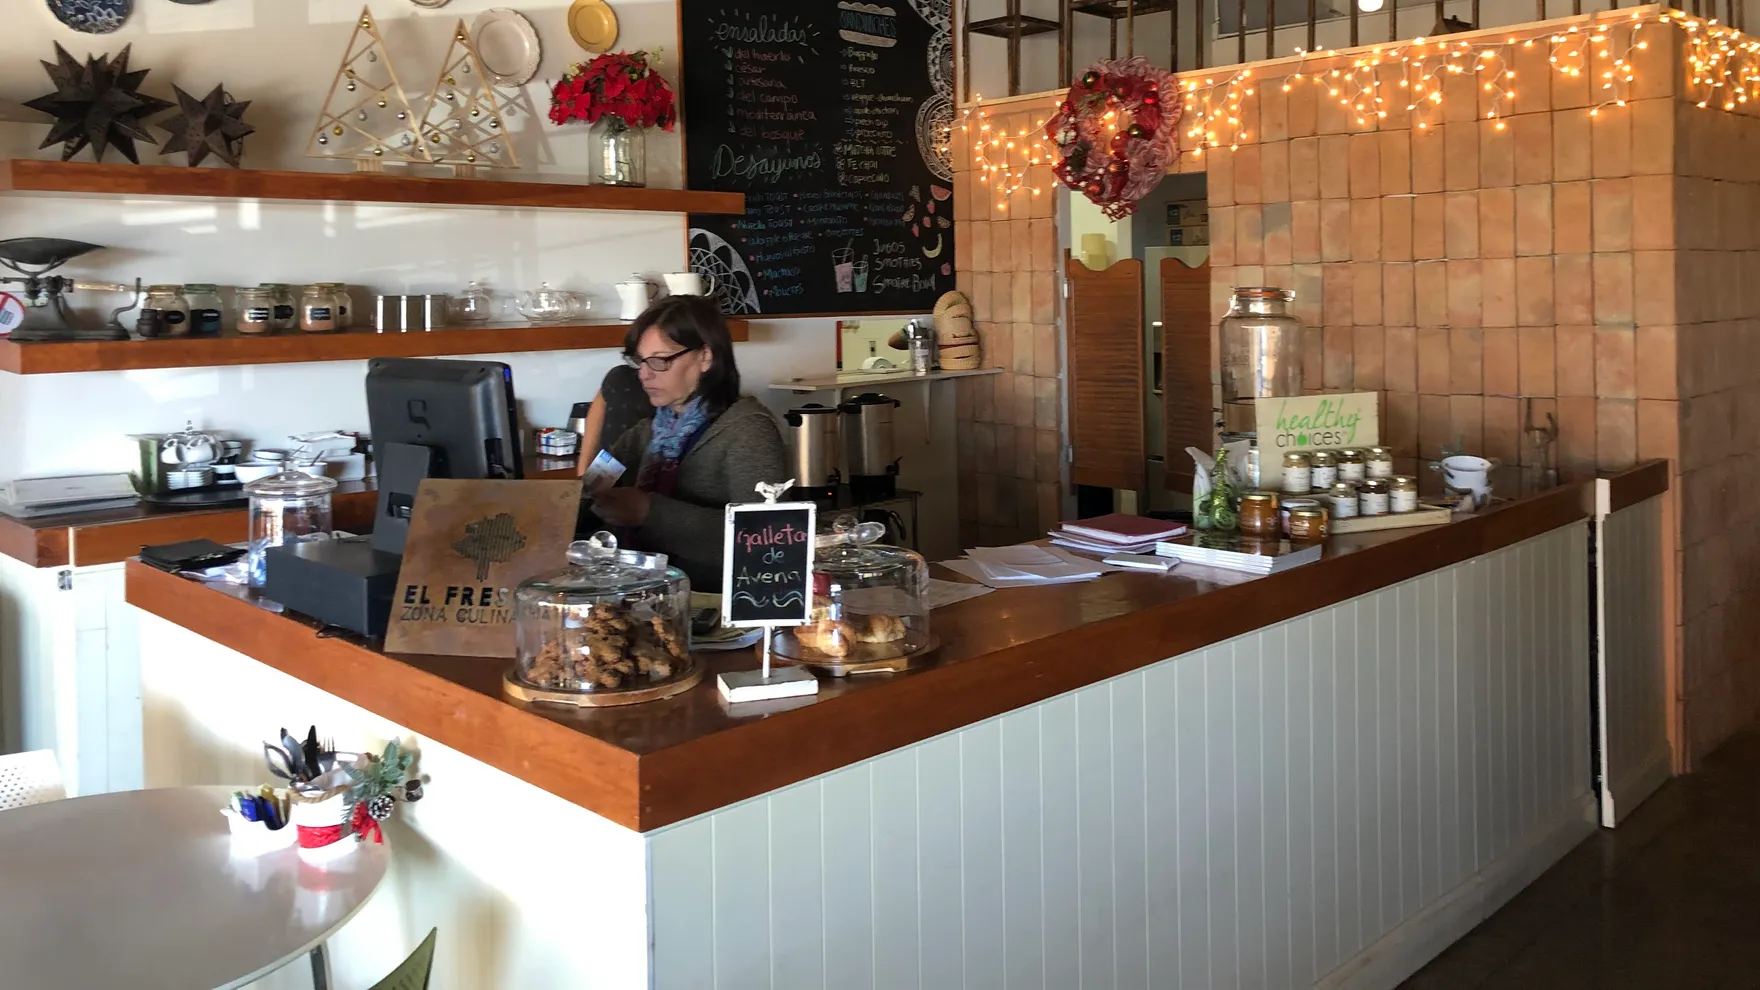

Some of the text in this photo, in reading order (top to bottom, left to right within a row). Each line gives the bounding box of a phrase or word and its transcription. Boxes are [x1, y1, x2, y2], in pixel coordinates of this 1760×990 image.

[715, 14, 808, 46] ensaladas
[760, 93, 799, 111] campo
[712, 144, 821, 184] Desayunos
[1276, 397, 1362, 444] healthy
[762, 548, 785, 564] de
[736, 566, 802, 588] Avena
[405, 585, 430, 604] EL
[400, 606, 550, 625] ZONA CULINAIA
